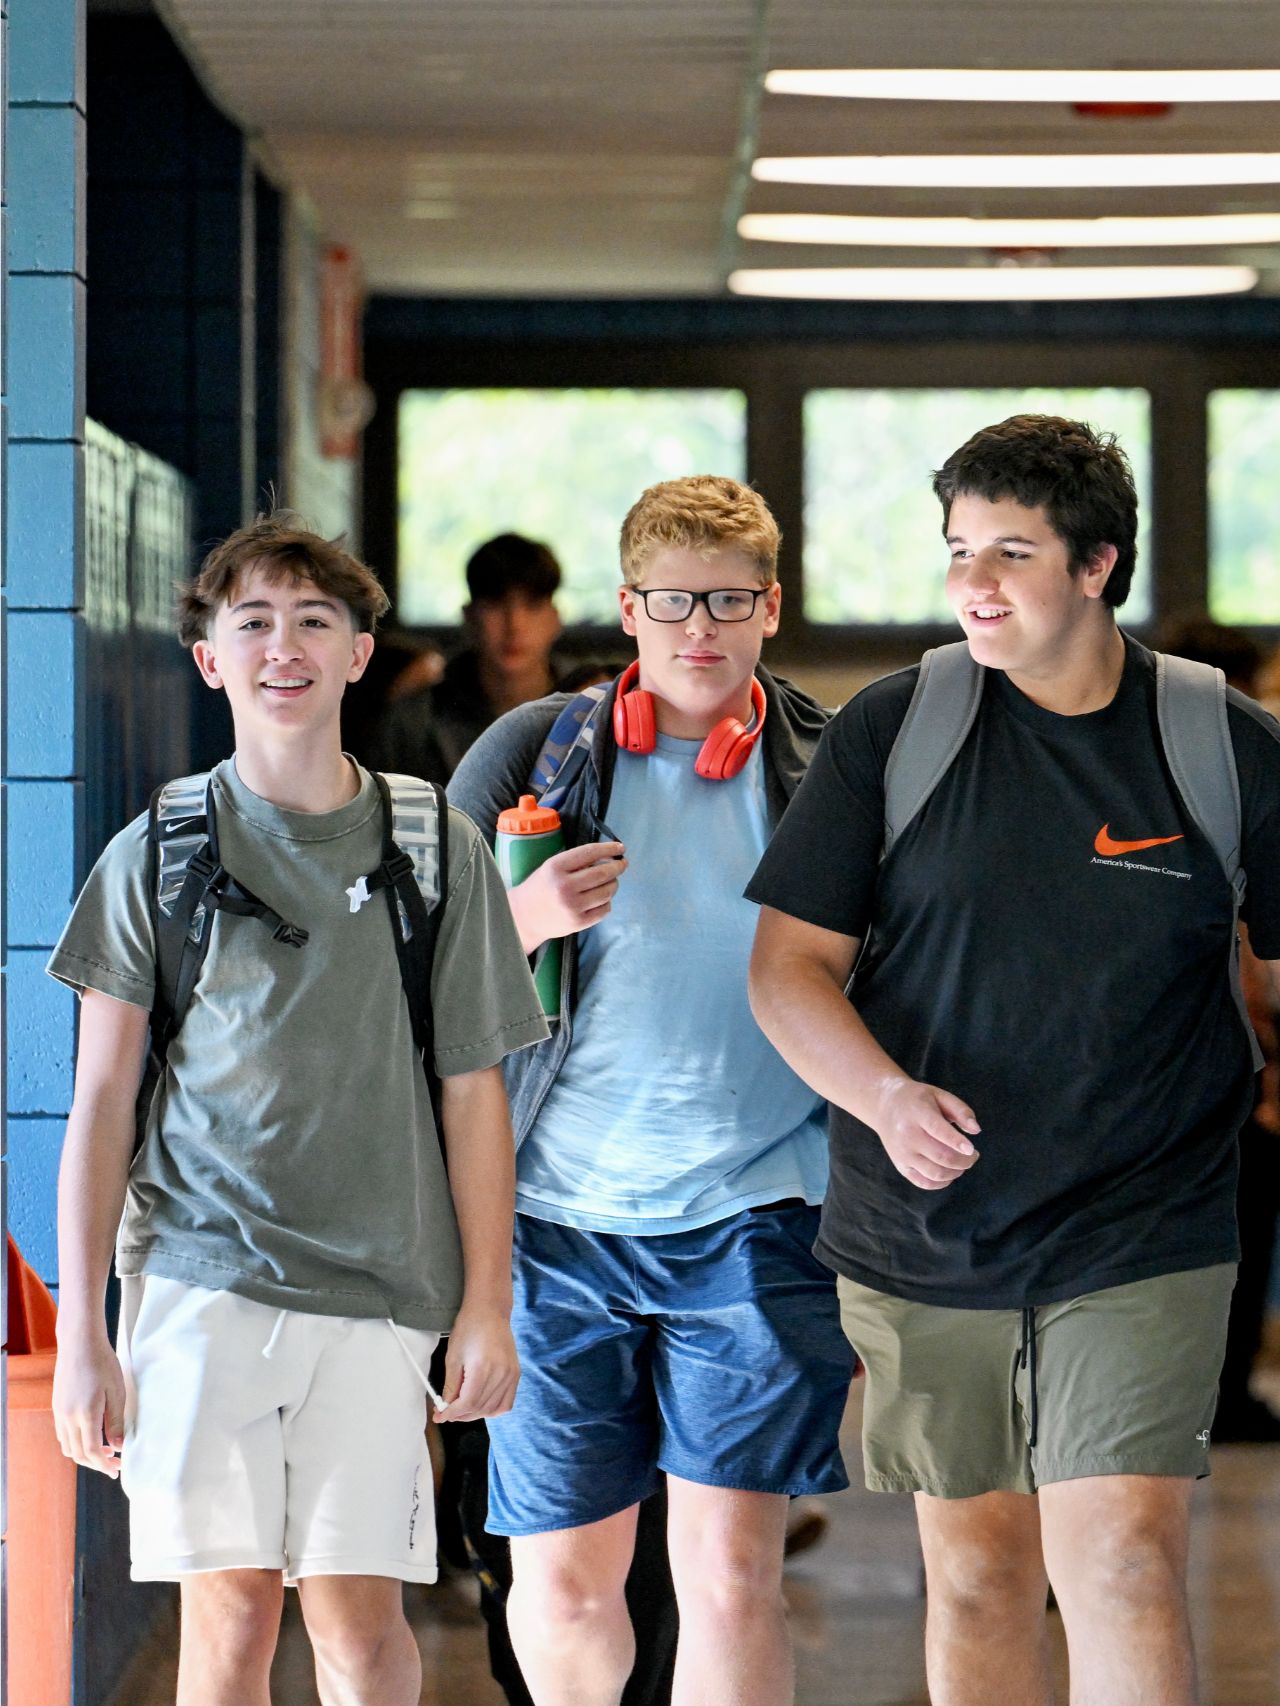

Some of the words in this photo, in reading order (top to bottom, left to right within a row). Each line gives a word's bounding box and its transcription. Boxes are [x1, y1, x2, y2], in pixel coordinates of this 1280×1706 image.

[1091, 856, 1123, 867] America's
[1123, 861, 1161, 873] Sportswear
[1161, 867, 1192, 880] Company
